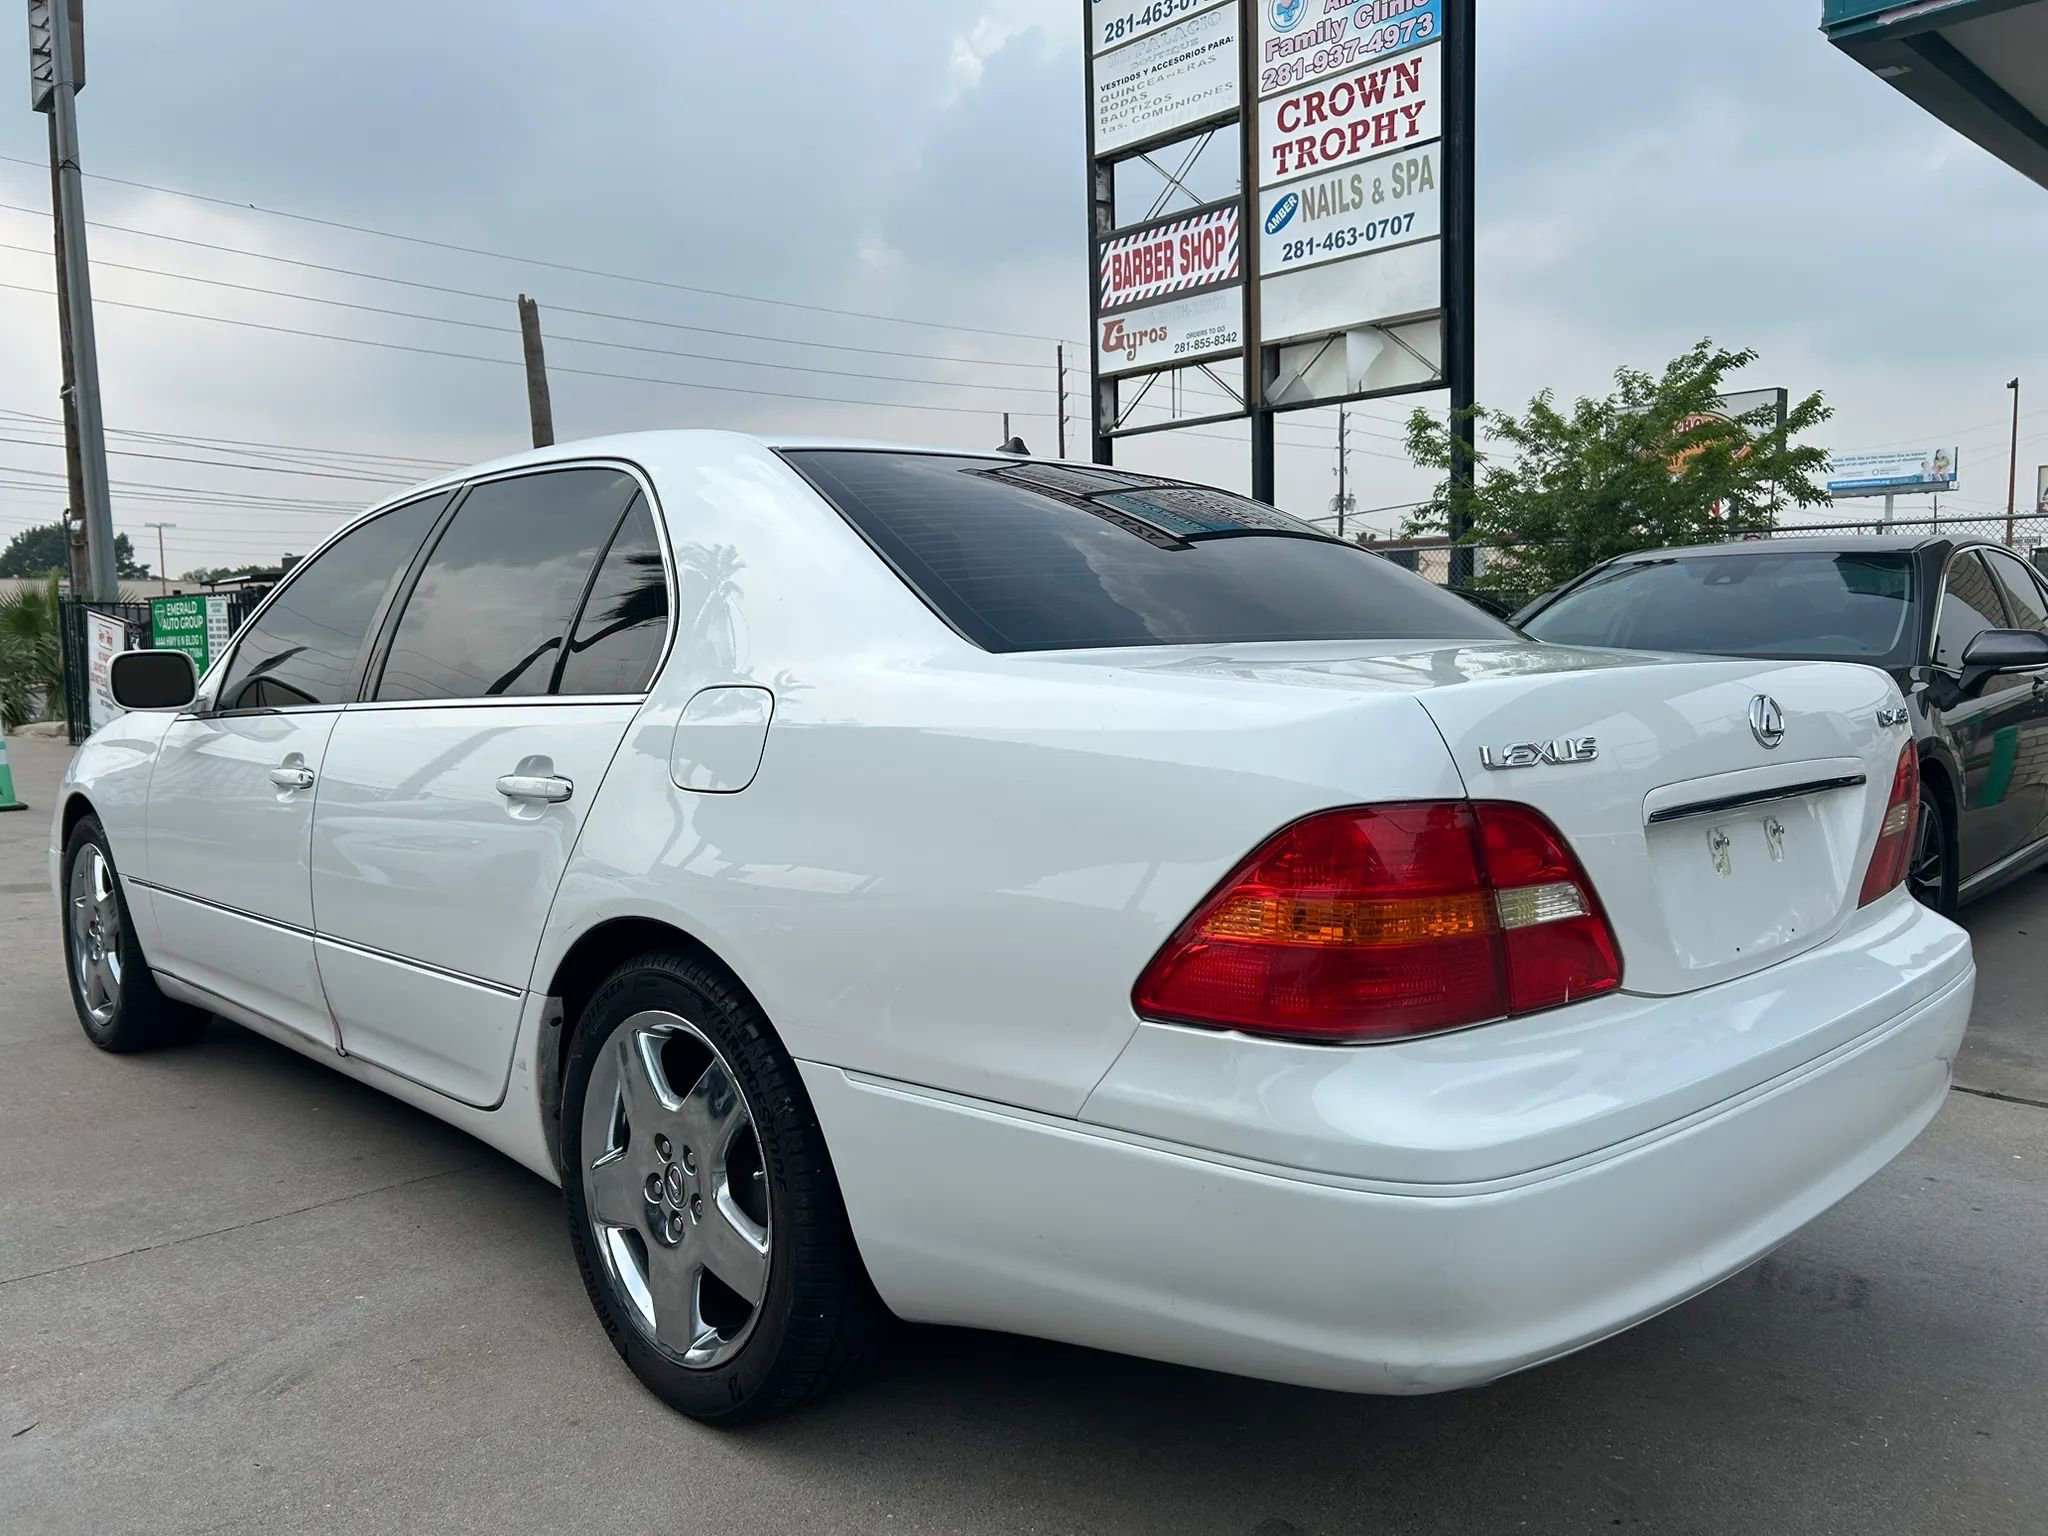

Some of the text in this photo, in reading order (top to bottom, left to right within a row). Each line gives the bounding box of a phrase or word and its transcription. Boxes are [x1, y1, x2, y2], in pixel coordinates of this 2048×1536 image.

[1262, 12, 1434, 92] 281-937-4973
[1265, 17, 1348, 62] Family
[1100, 72, 1141, 92] VESTIDOS
[1151, 46, 1206, 73] ACCESORIOS
[1207, 36, 1234, 51] PARA:
[1100, 92, 1148, 115] BODAS
[1100, 93, 1173, 125] BAUTIZOS
[1132, 82, 1233, 124] COMUNIONES
[1277, 56, 1422, 133] CROWN
[1272, 100, 1426, 175] TROPHY
[1301, 154, 1434, 223] NAILS & SPA
[1266, 195, 1298, 233] AMBER
[1282, 212, 1415, 262] 281-463-0707
[1112, 225, 1226, 292] BARBER SHOP
[1101, 318, 1168, 361] Gyros
[1174, 332, 1237, 353] 281-855-8342
[1186, 329, 1208, 339] ORDERS
[162, 617, 179, 630] AUTO
[180, 615, 203, 629] GROUP
[166, 601, 197, 616] EMERALD
[186, 635, 200, 645] BLDG
[1479, 736, 1599, 770] LEXUS
